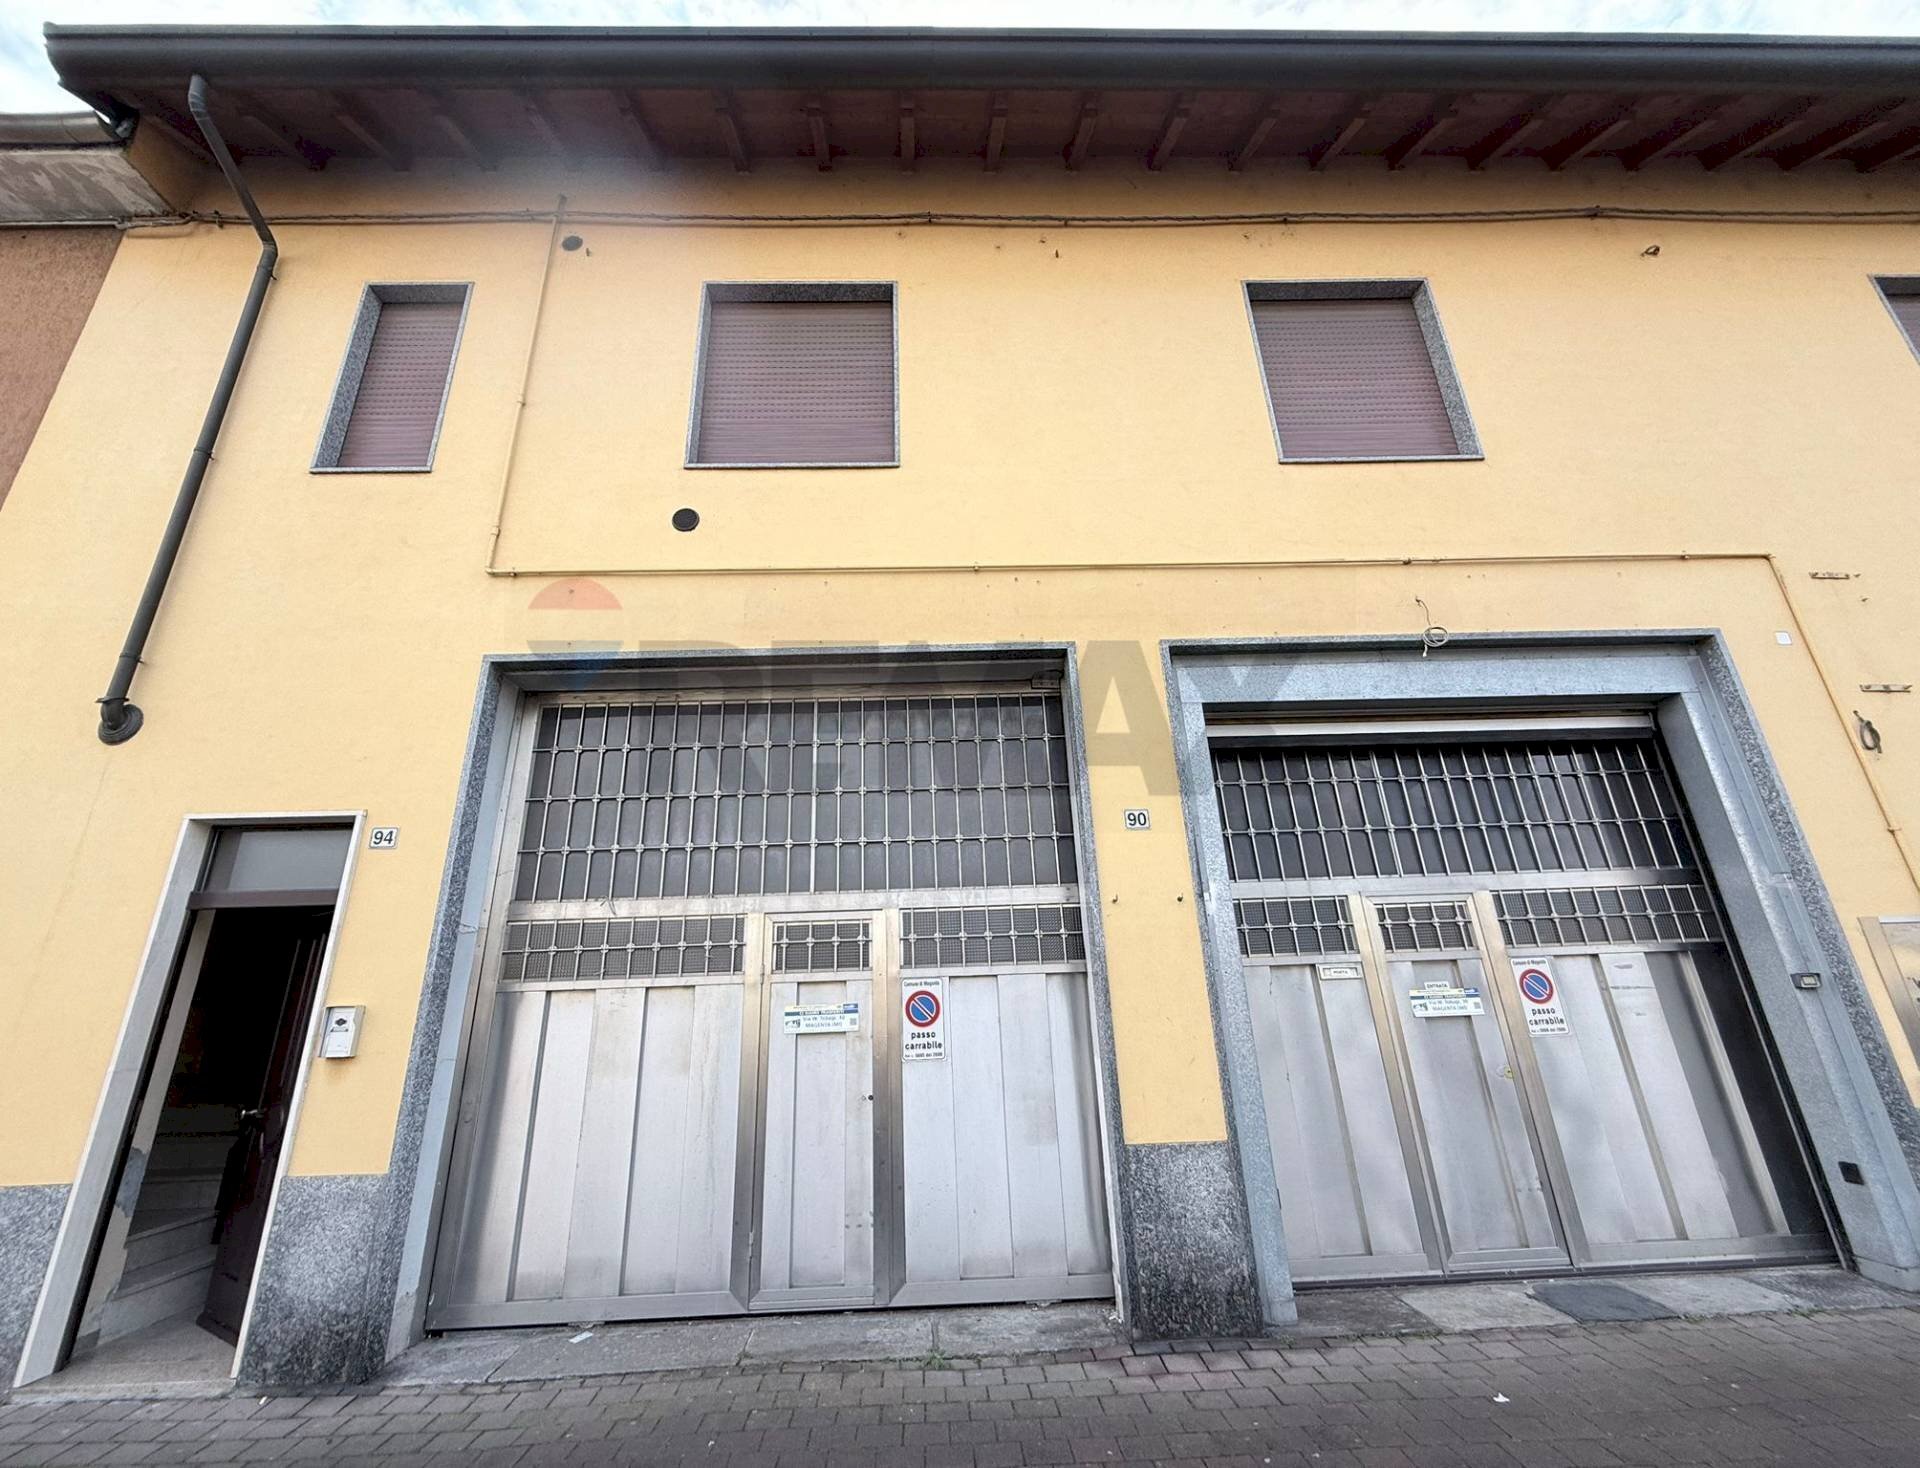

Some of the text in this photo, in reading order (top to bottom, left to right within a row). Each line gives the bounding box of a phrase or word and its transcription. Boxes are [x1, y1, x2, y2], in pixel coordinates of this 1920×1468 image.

[1127, 812, 1146, 826] 90
[373, 830, 393, 845] 94
[1532, 1008, 1555, 1016] passo
[1529, 1017, 1564, 1026] carrabile
[911, 1032, 936, 1040] passo
[905, 1041, 942, 1050] carrabile
